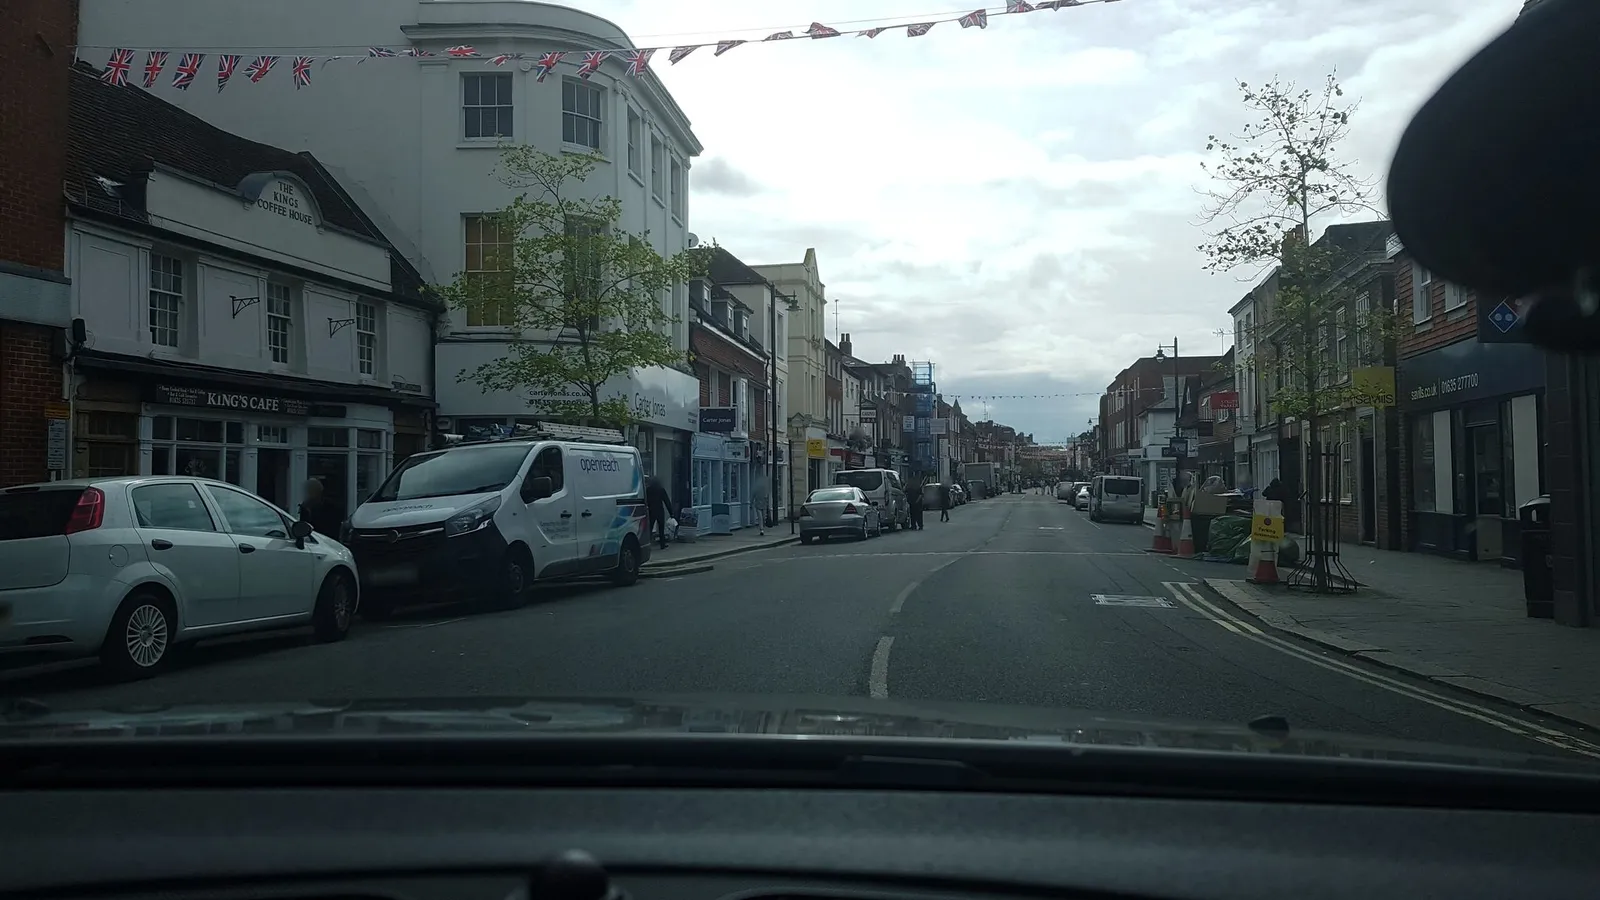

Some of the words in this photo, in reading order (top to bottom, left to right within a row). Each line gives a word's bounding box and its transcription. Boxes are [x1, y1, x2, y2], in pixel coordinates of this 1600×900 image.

[278, 181, 294, 196] THE
[273, 191, 299, 208] KINGS
[257, 198, 287, 217] COFFEE
[289, 209, 313, 225] HOUSE
[1410, 383, 1438, 401] savills.co.uk
[1441, 379, 1457, 394] 01635
[1457, 373, 1479, 391] 277700
[207, 392, 248, 408] KING'S
[634, 392, 652, 416] Carter
[652, 396, 667, 418] Jonas
[580, 458, 621, 473] openreach
